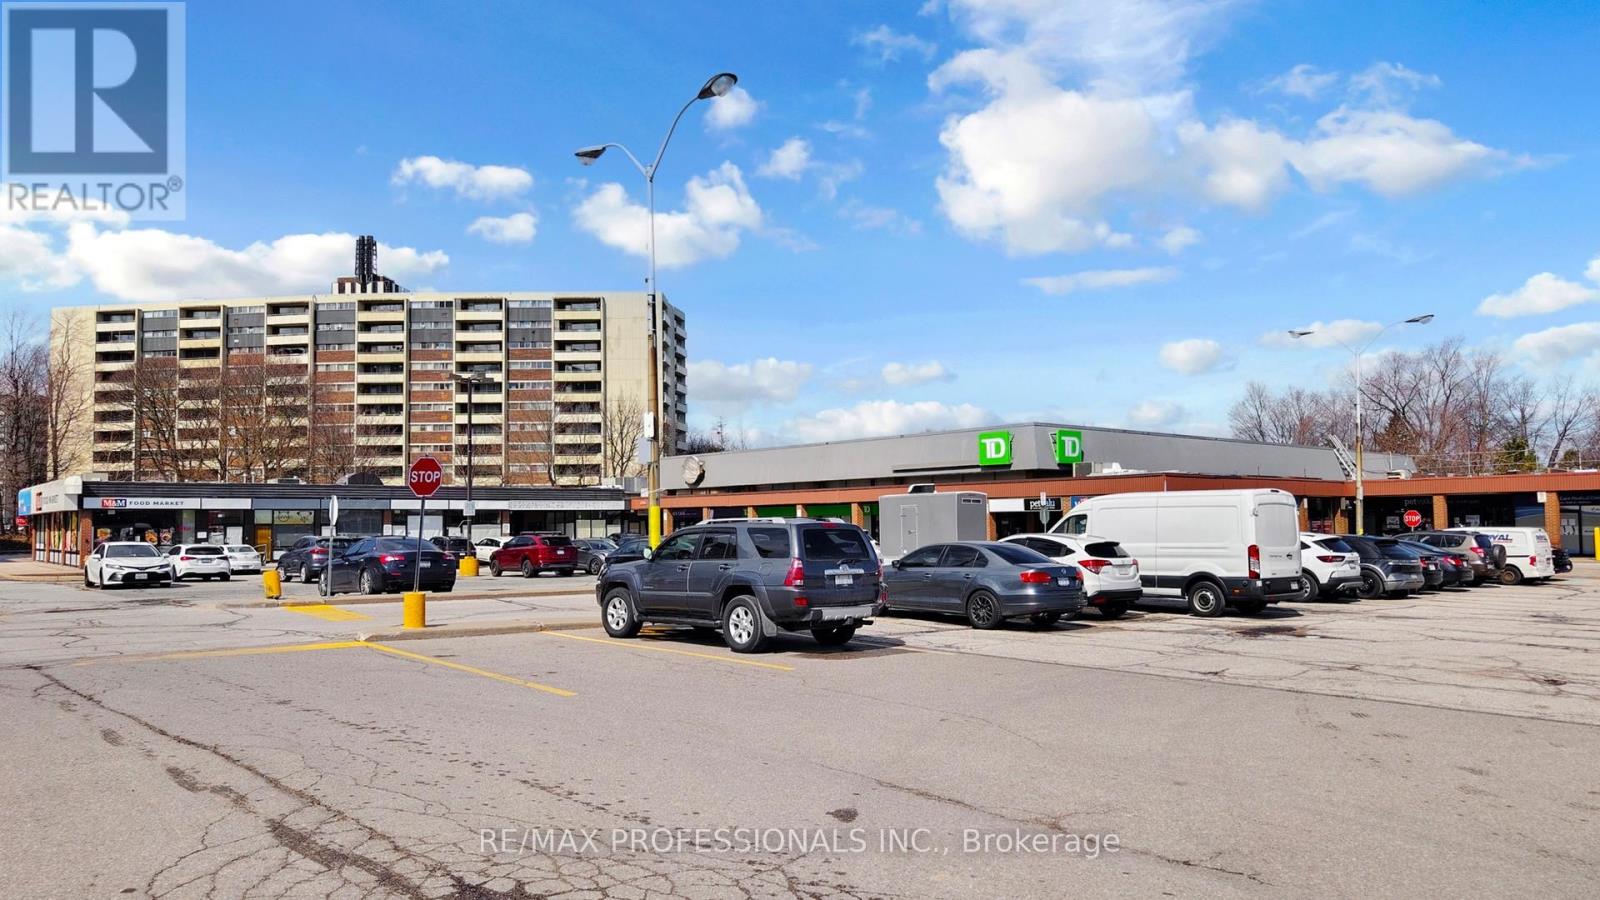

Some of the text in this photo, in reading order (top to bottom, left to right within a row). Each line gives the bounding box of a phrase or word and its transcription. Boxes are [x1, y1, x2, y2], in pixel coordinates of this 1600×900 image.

[981, 438, 1006, 459] TD
[1061, 436, 1080, 457] TD
[411, 471, 440, 482] STOP
[102, 499, 126, 507] M&M
[1029, 498, 1056, 509] petalu
